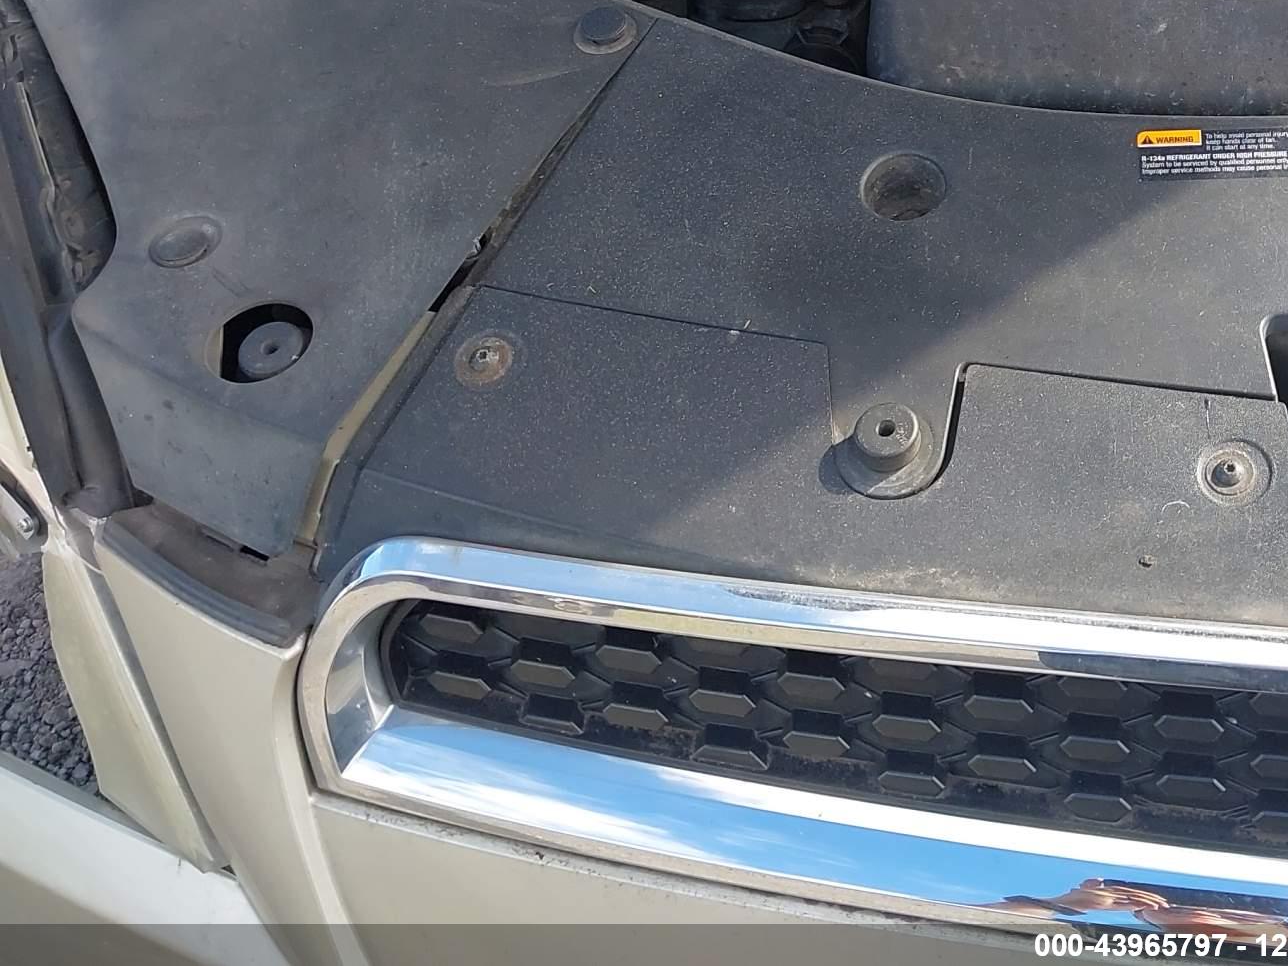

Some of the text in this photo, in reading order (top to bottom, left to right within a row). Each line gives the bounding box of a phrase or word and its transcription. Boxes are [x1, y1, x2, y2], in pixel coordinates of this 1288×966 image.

[1156, 135, 1194, 144] WARNING
[1166, 153, 1211, 161] REFRIGERANT
[1212, 152, 1236, 160] UNDER
[1236, 151, 1253, 159] HIGH
[1253, 150, 1288, 158] PRESSURE
[1218, 158, 1245, 166] qualified
[1245, 157, 1276, 165] personnel
[1222, 165, 1236, 173] may
